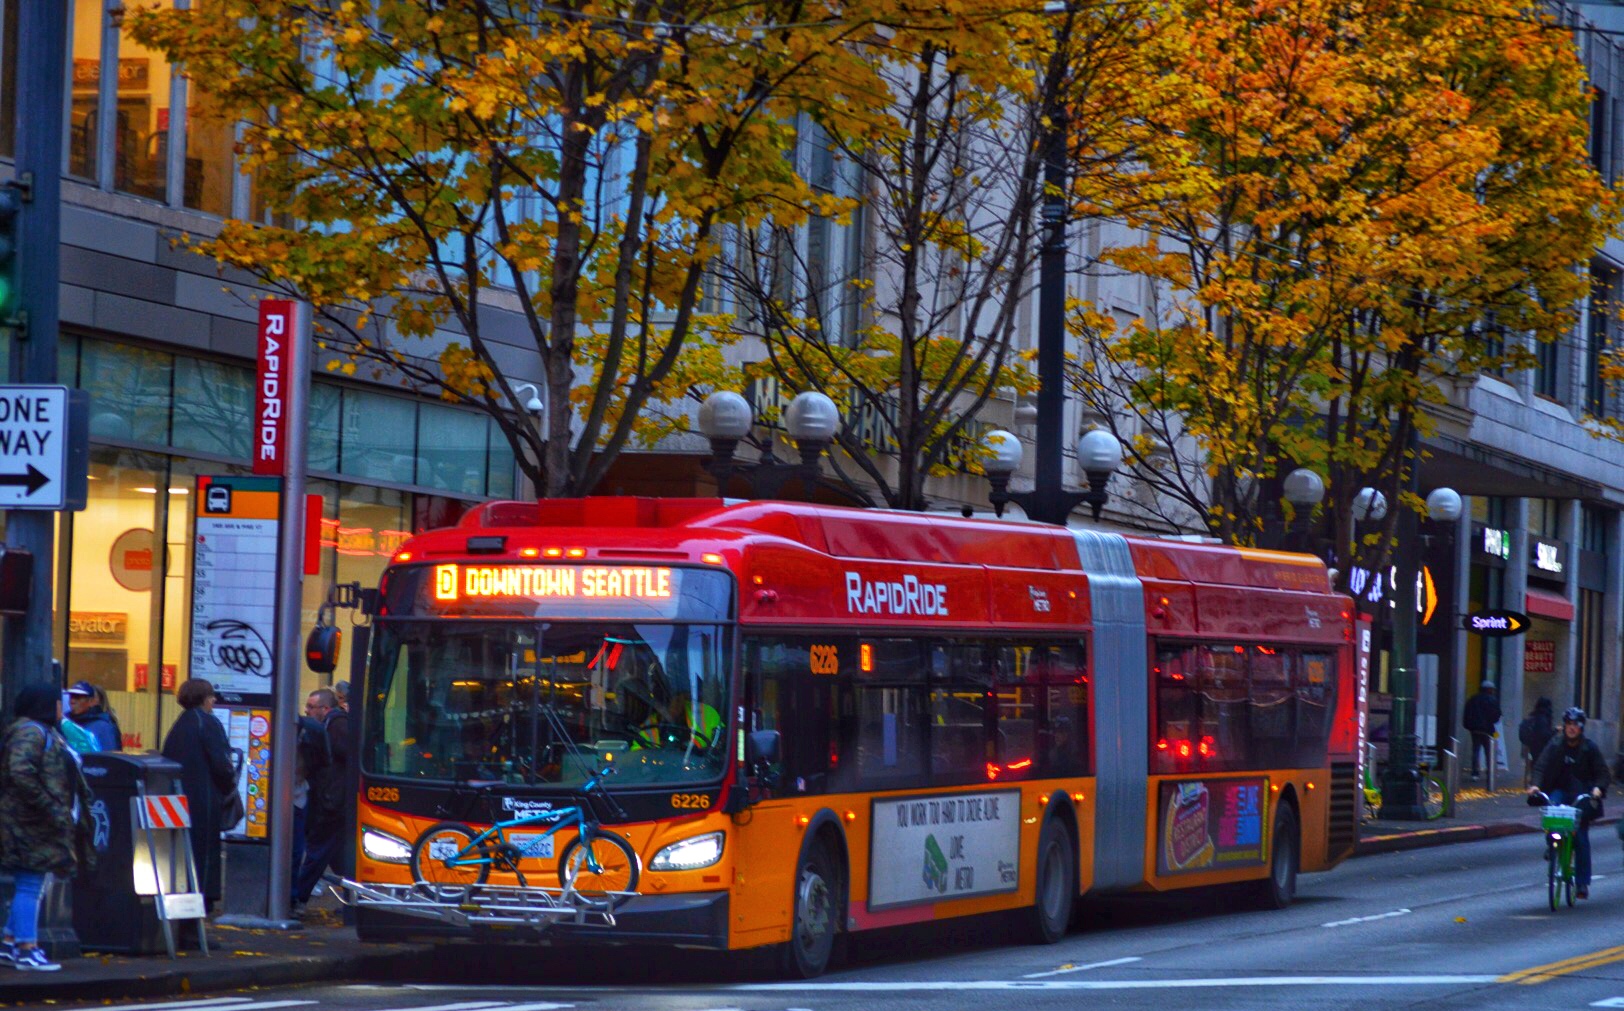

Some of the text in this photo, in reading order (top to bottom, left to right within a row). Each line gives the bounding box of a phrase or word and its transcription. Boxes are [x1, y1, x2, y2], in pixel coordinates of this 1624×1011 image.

[0, 397, 50, 422] ONE
[465, 568, 576, 597] DOWNTOWN
[582, 568, 671, 598] SEATTLE
[845, 571, 949, 616] RAPIDRIDE
[1472, 616, 1507, 630] Sprint
[809, 644, 839, 675] 6226
[367, 786, 400, 802] 6226
[671, 793, 710, 809] 6226
[514, 801, 553, 810] King County
